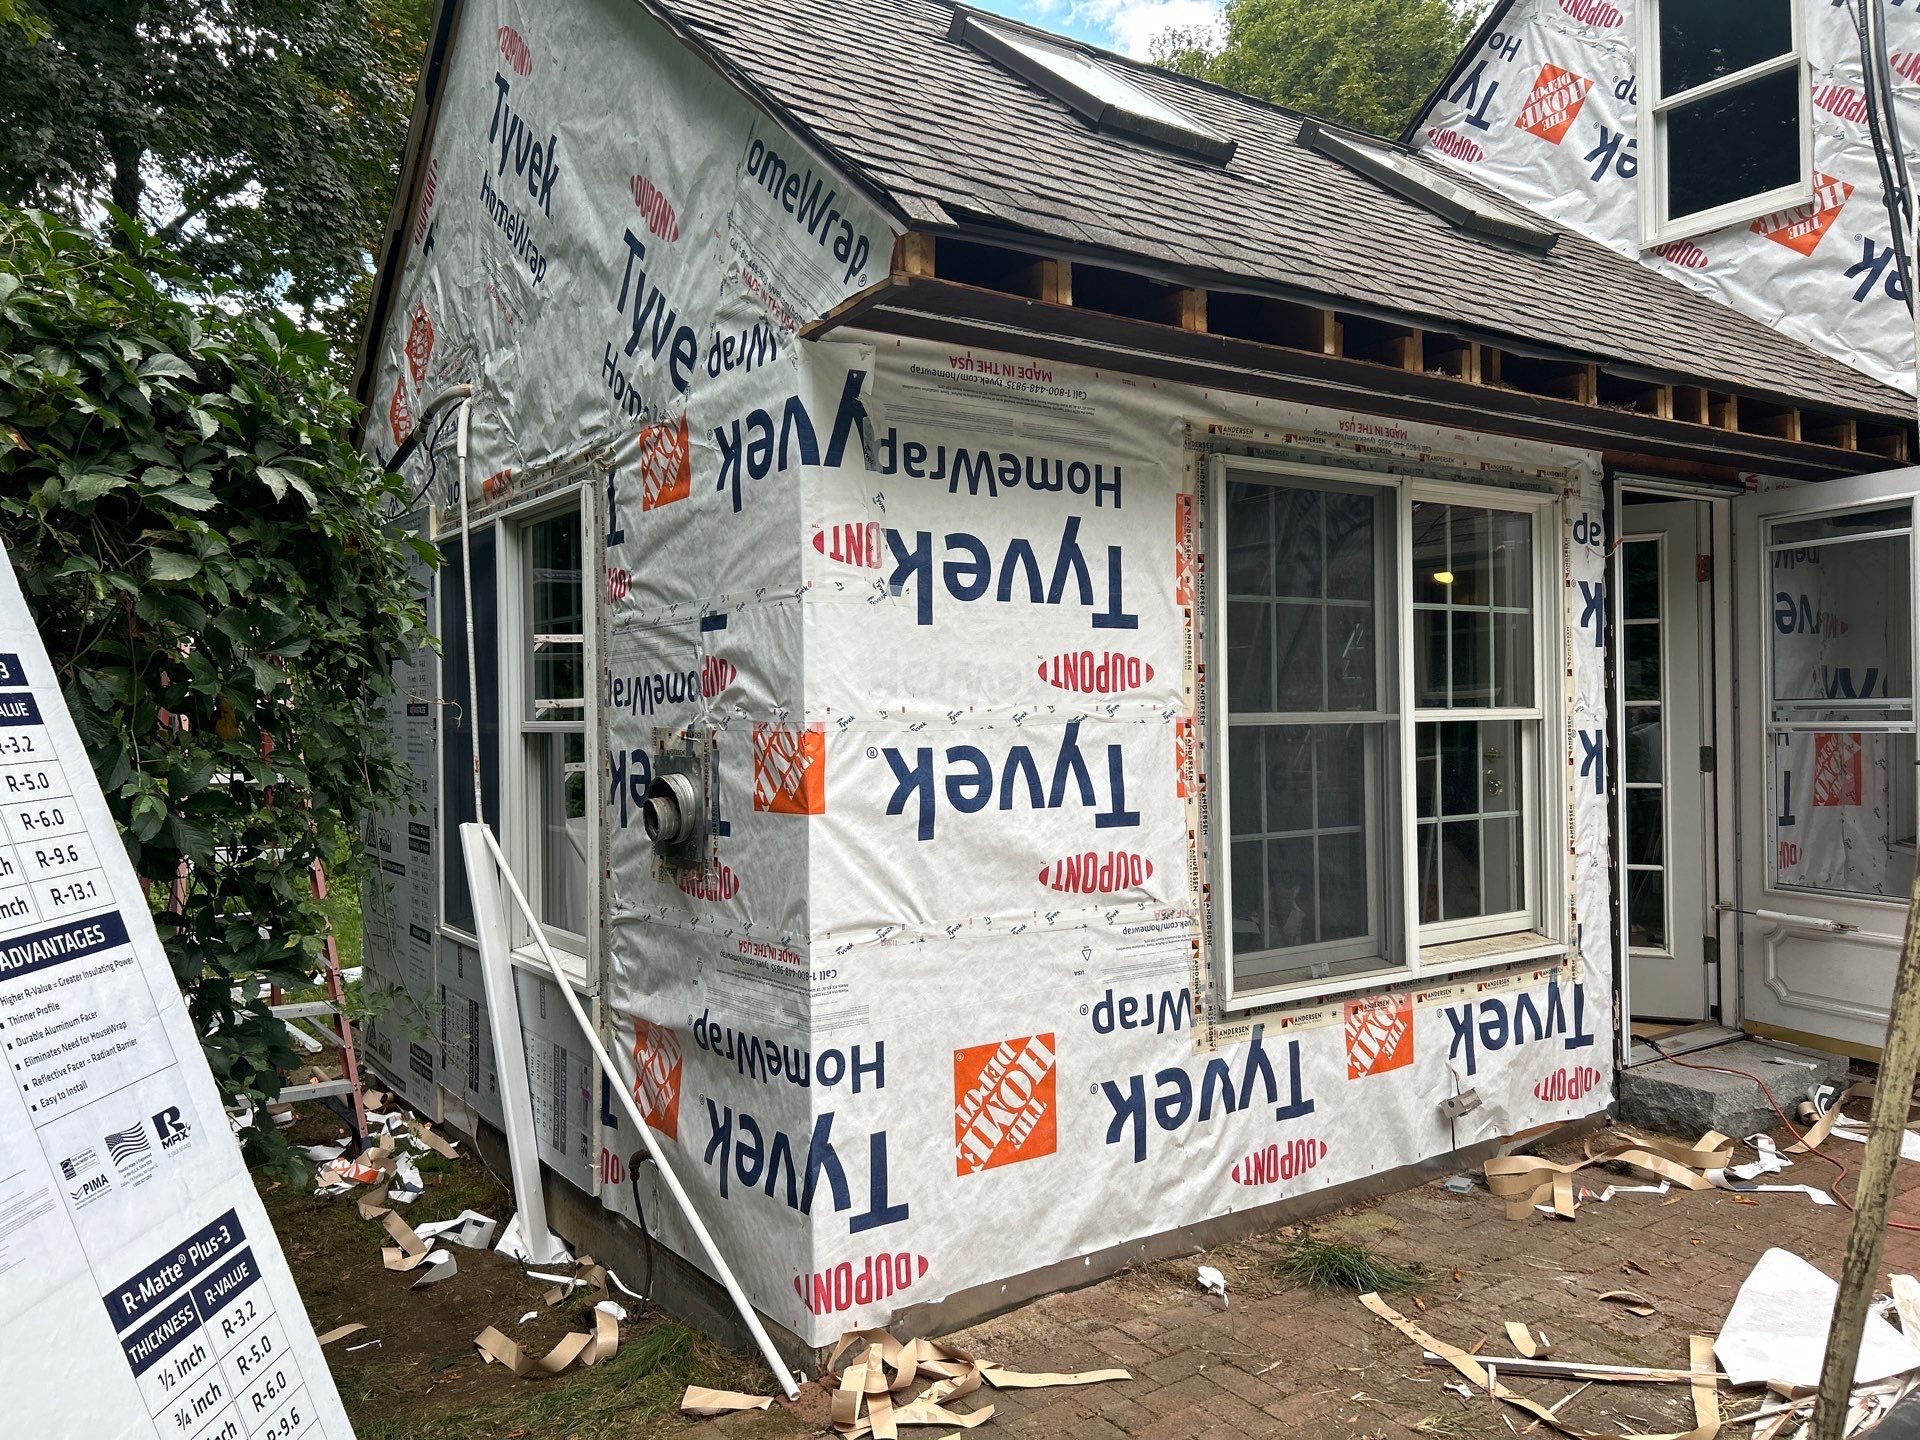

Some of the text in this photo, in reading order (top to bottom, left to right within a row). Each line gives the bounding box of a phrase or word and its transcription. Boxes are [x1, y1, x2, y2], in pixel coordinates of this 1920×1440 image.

[489, 71, 560, 219] Tyvek
[1432, 128, 1478, 162] DUPONT
[480, 169, 548, 288] HomeWrap
[635, 175, 679, 243] DUPONT
[747, 138, 870, 286] omeWrap
[617, 227, 697, 394] Tyve
[910, 364, 1087, 401] Call 1-800-448-9835 tyvek.com/homewrap
[948, 356, 1053, 383] MADE IN THE USA
[713, 369, 867, 514] yvek
[1223, 426, 1255, 435] ANDERSEN
[1338, 420, 1408, 441] MADE IN THE USA
[829, 522, 882, 570] ONT
[885, 515, 1140, 630] Tyvek
[1051, 650, 1142, 694] DUPONT
[0, 702, 29, 718] ALUE
[5, 772, 50, 793] R-5.0
[881, 719, 1142, 842] Tyvek
[20, 808, 65, 830] R-6.0
[35, 845, 79, 868] R-9.6
[1051, 851, 1144, 895] DUPONT
[0, 898, 29, 920] nch
[50, 880, 97, 907] R-13.1
[0, 923, 106, 970] ADVANTAGES
[738, 940, 801, 966] MADE IN THE USA
[0, 992, 24, 1007] Higher
[24, 982, 52, 998] R-Value
[57, 973, 83, 988] Greater
[83, 963, 115, 980] Insulating
[114, 956, 134, 969] Power
[819, 969, 837, 981] Call
[1427, 989, 1452, 1000] ANDERSEN
[1487, 977, 1510, 988] ANDERSEN
[7, 1002, 61, 1027] Thinner Profile
[15, 1010, 98, 1047] Durable Aluminum Facer
[1091, 986, 1192, 1035] Wrap
[1219, 1024, 1250, 1036] ANDERSEN
[1295, 1012, 1322, 1023] ANDERSEN
[1444, 980, 1594, 1077] Tyvek
[23, 1020, 128, 1068] Eliminates Need for HouseWrap
[31, 1067, 68, 1088] Reflective
[67, 1059, 86, 1073] Facer
[90, 1047, 117, 1063] Radiant
[116, 1038, 138, 1052] Barrier
[692, 1008, 886, 1095] HomeWrap
[39, 1080, 89, 1109] Easy to Install
[954, 1034, 1057, 1173] THE HOME DEPOT
[1101, 1023, 1316, 1165] Tyvek
[161, 1128, 190, 1150] MAX
[704, 1097, 910, 1235] Tyvek
[1243, 1138, 1318, 1187] DUPONT
[82, 1173, 110, 1195] PIMA
[188, 1225, 232, 1267] Plus-3
[204, 1261, 250, 1306] R-VALUE
[803, 1252, 913, 1316] DUPONT
[128, 1304, 195, 1365] THICKNESS
[221, 1300, 257, 1339] R-3.2
[174, 1343, 207, 1379] inch
[236, 1335, 272, 1376] R-5.0
[190, 1382, 223, 1418] inch
[251, 1371, 287, 1413] R-6.0
